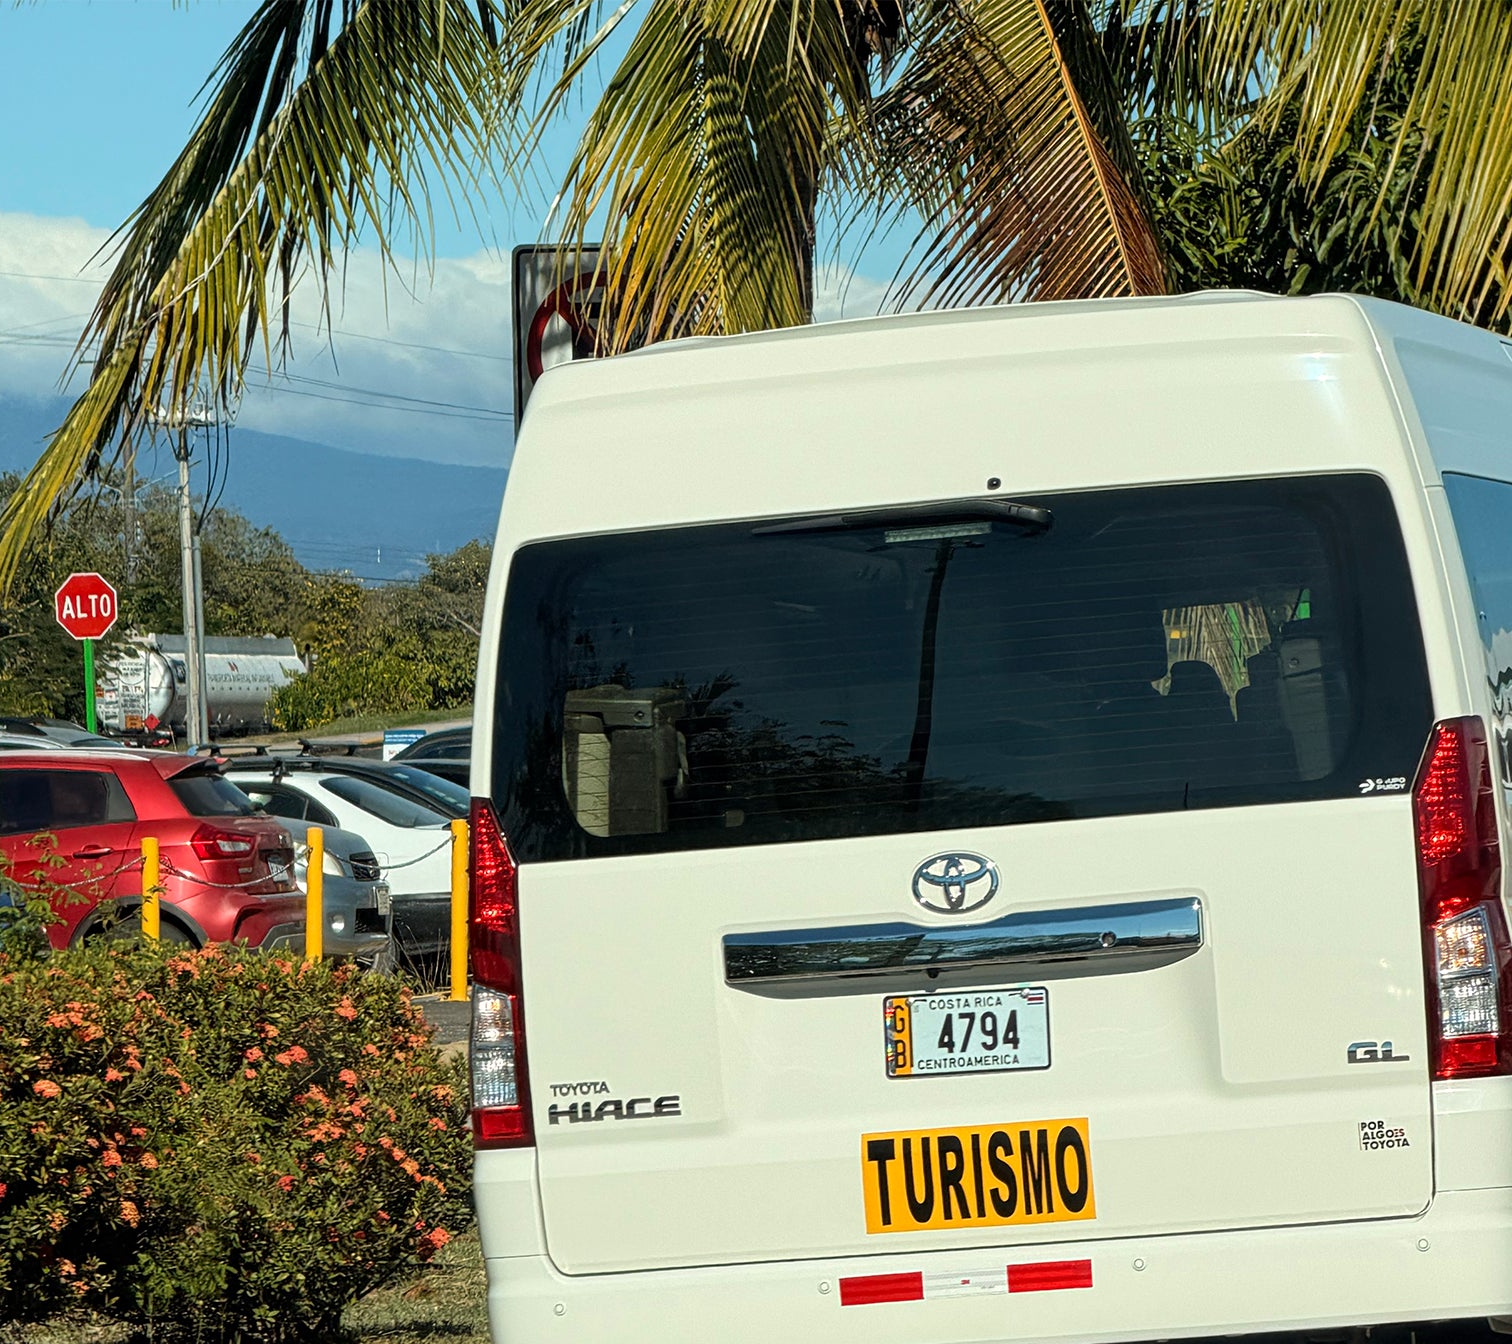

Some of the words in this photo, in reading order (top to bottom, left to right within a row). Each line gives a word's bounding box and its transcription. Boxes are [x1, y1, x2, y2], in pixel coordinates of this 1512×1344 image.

[62, 594, 111, 619] ALTO
[929, 998, 970, 1010] COSTA
[975, 996, 1003, 1008] RICA
[938, 1009, 1020, 1053] 4794
[917, 1054, 1020, 1070] CENTROAMERICA
[1347, 1041, 1410, 1064] GL
[550, 1081, 610, 1097] TOYOTA
[548, 1095, 682, 1125] HIACE
[1360, 1120, 1385, 1131] POR
[1362, 1138, 1410, 1151] TOYOTA
[867, 1125, 1088, 1226] TURISMO
